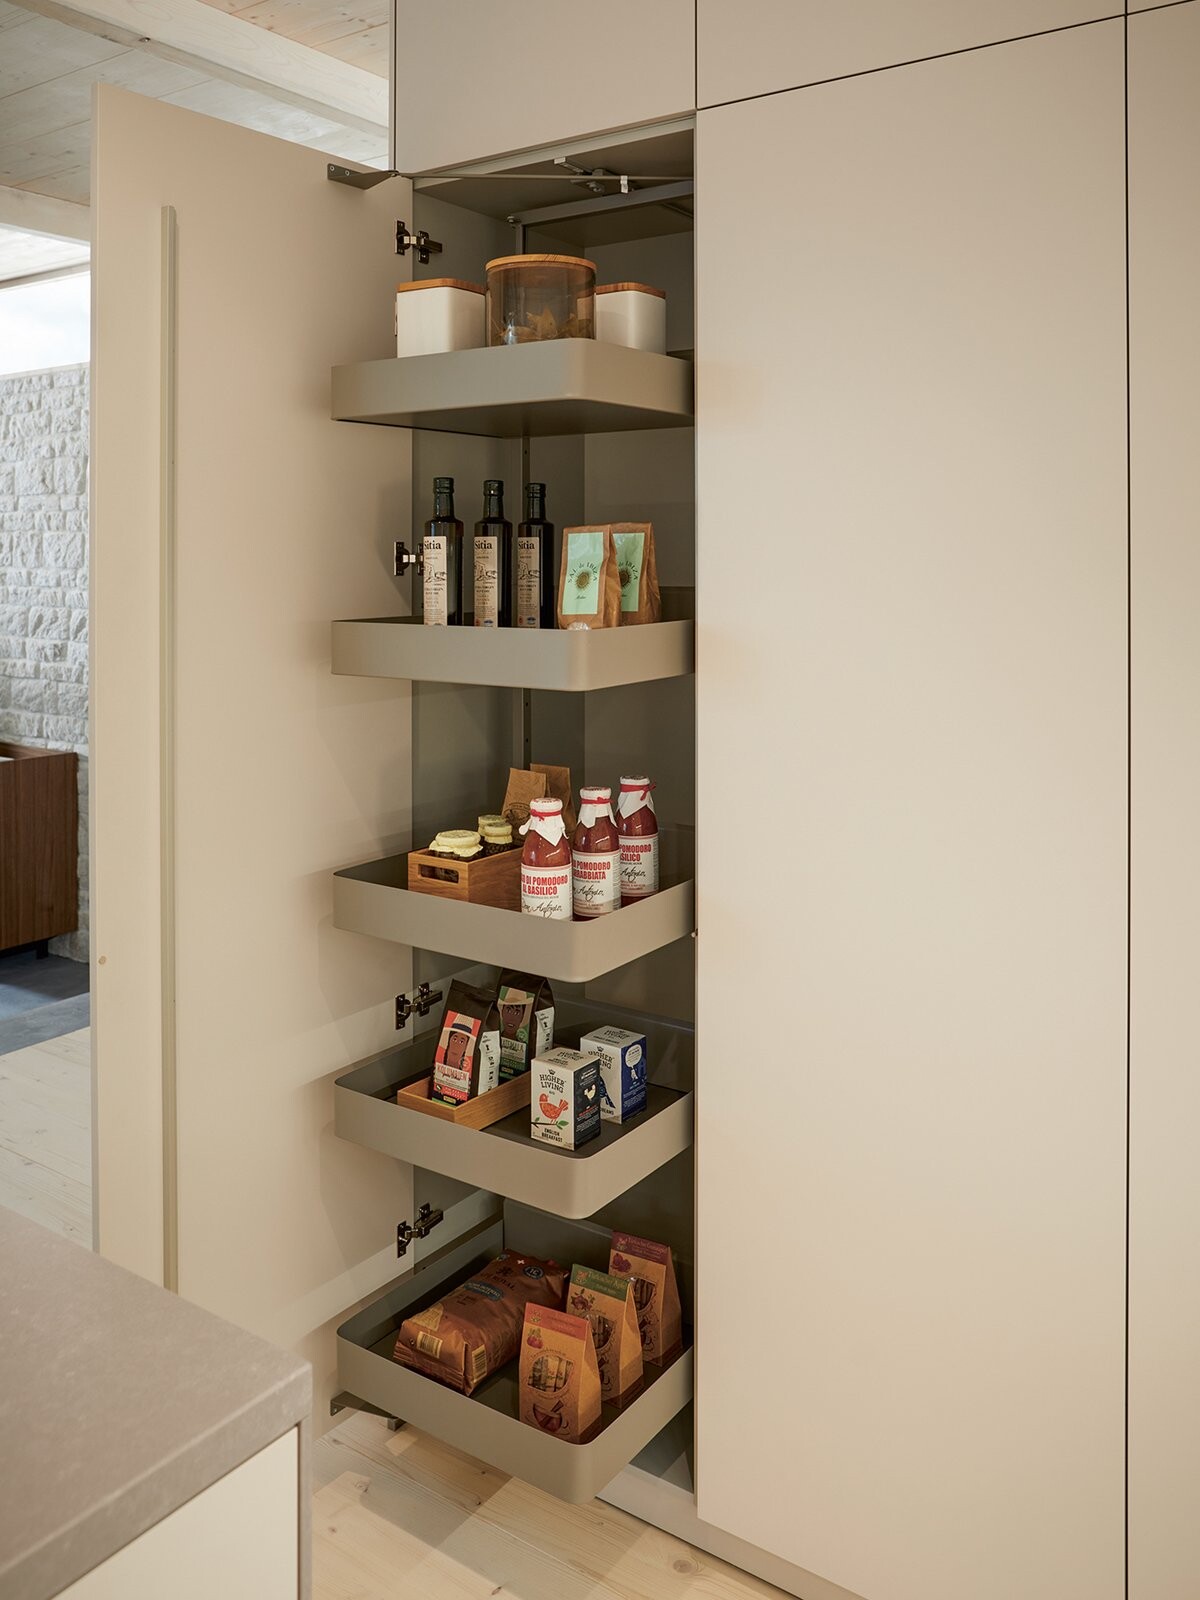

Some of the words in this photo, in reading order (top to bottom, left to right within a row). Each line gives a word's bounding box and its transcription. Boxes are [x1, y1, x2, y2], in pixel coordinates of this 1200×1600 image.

[577, 860, 611, 871] POMODORO
[533, 875, 568, 886] POMODORO
[528, 885, 558, 896] BASILICO
[539, 1074, 565, 1087] HIGHER
[541, 1082, 564, 1093] LIVING
[541, 1132, 563, 1143] BREAKFAST
[544, 1128, 560, 1136] ENGLISH
